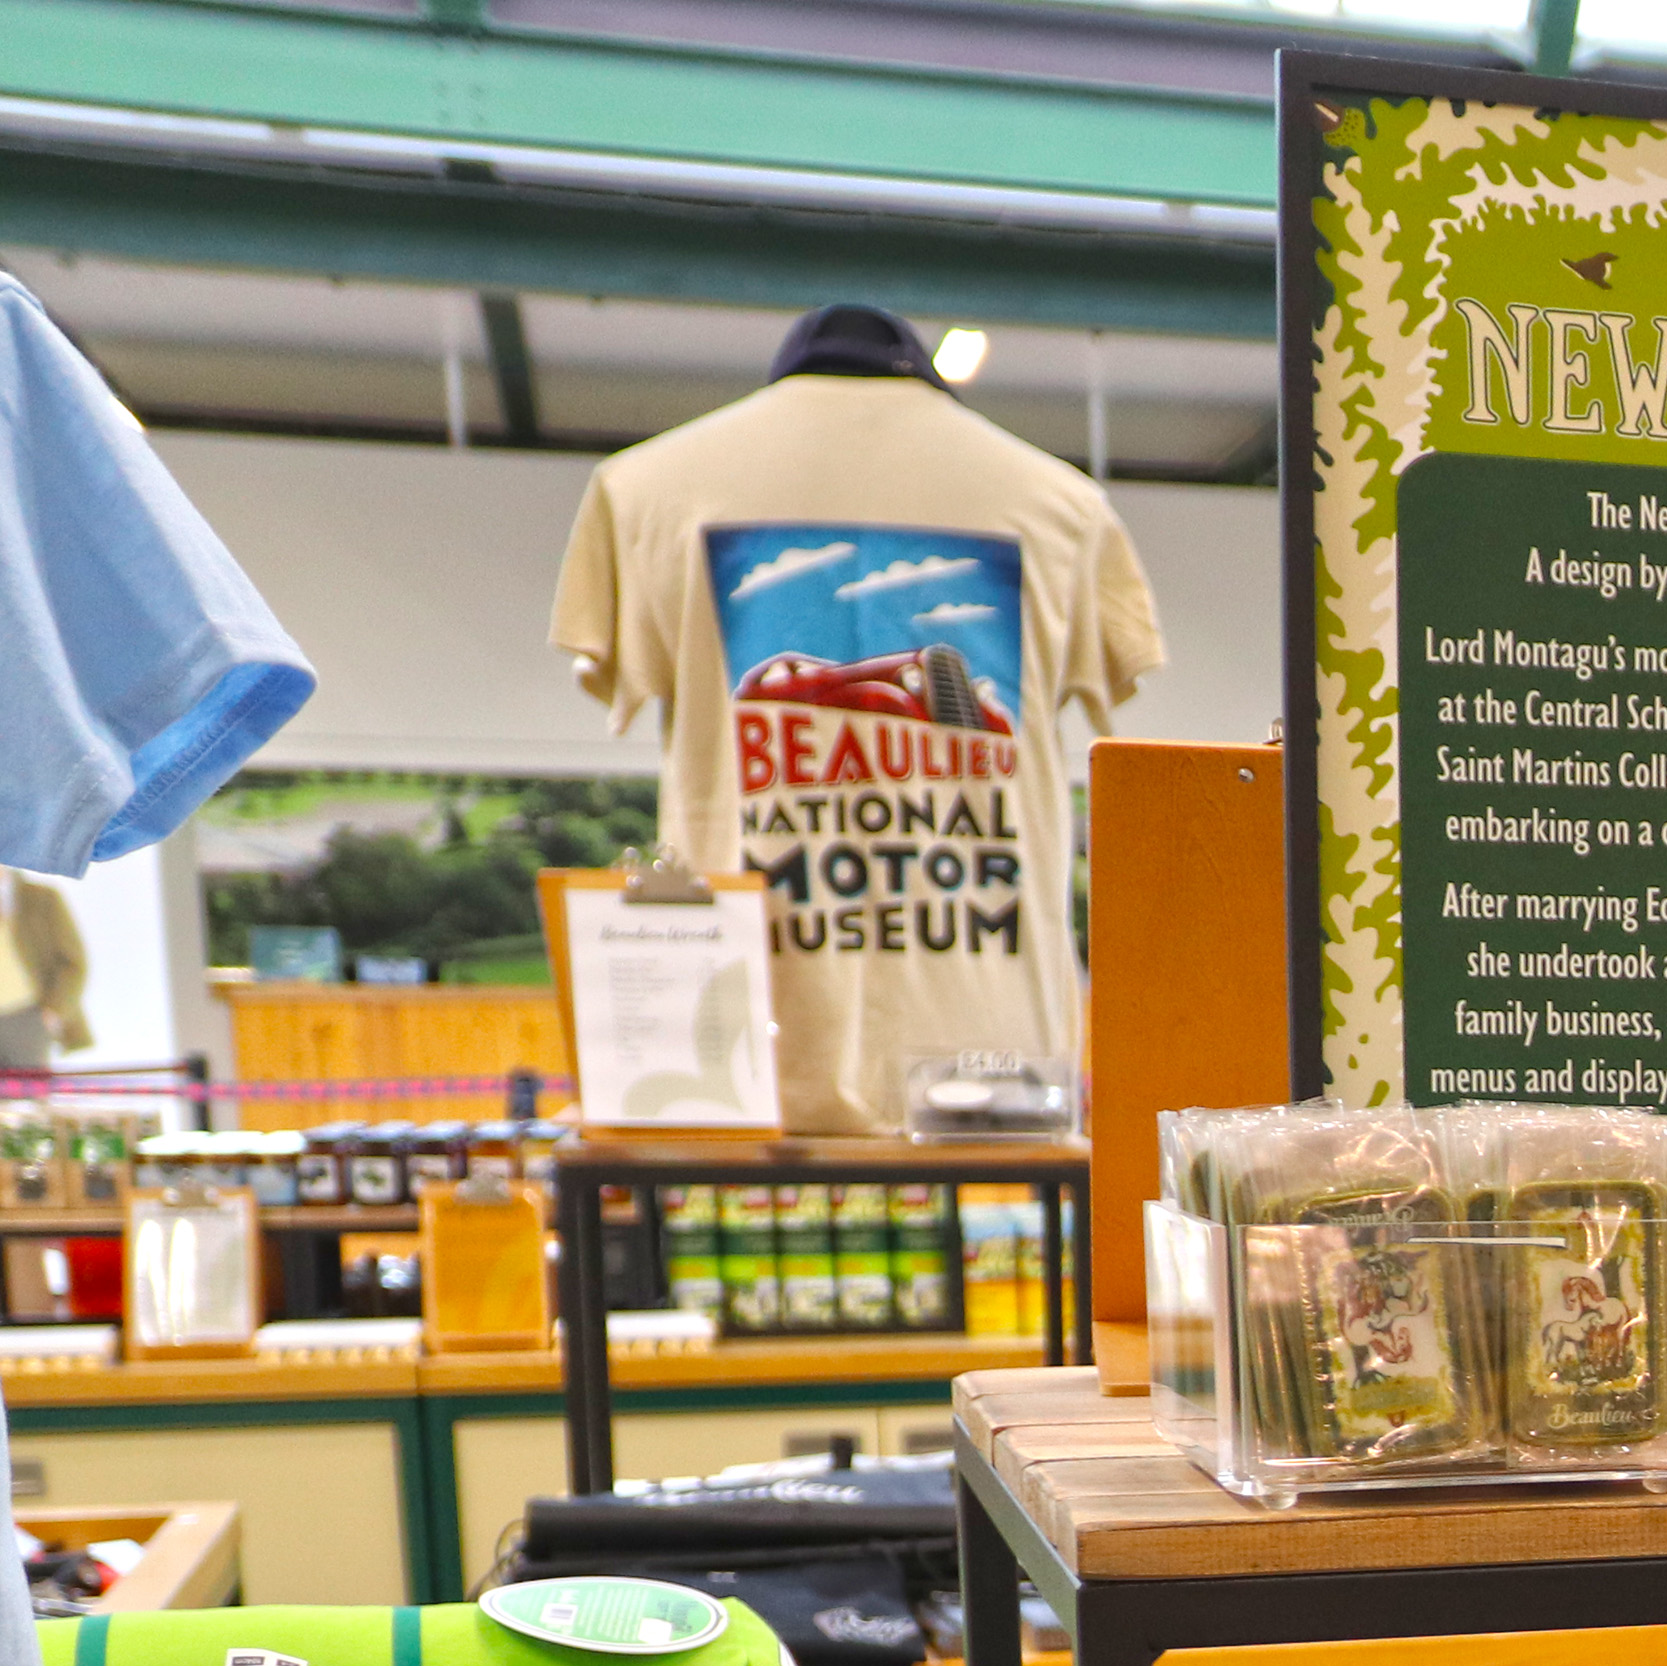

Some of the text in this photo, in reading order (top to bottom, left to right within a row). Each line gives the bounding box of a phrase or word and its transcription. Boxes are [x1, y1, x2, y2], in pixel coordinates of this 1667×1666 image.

[1586, 491, 1632, 530] The
[1525, 547, 1544, 584] A
[1550, 549, 1632, 599] design
[1426, 626, 1485, 665] Lord
[1494, 630, 1626, 681] Montagu's
[735, 710, 1017, 795] BEAULIEU
[1437, 745, 1505, 784] Saint
[1513, 748, 1611, 787] Martins
[741, 787, 1017, 838] NATIONAL
[742, 843, 1020, 904] MOTOR
[1442, 882, 1509, 919] After
[1516, 885, 1639, 933] marrying
[1431, 1068, 1517, 1096] menus
[1524, 1059, 1573, 1096] and
